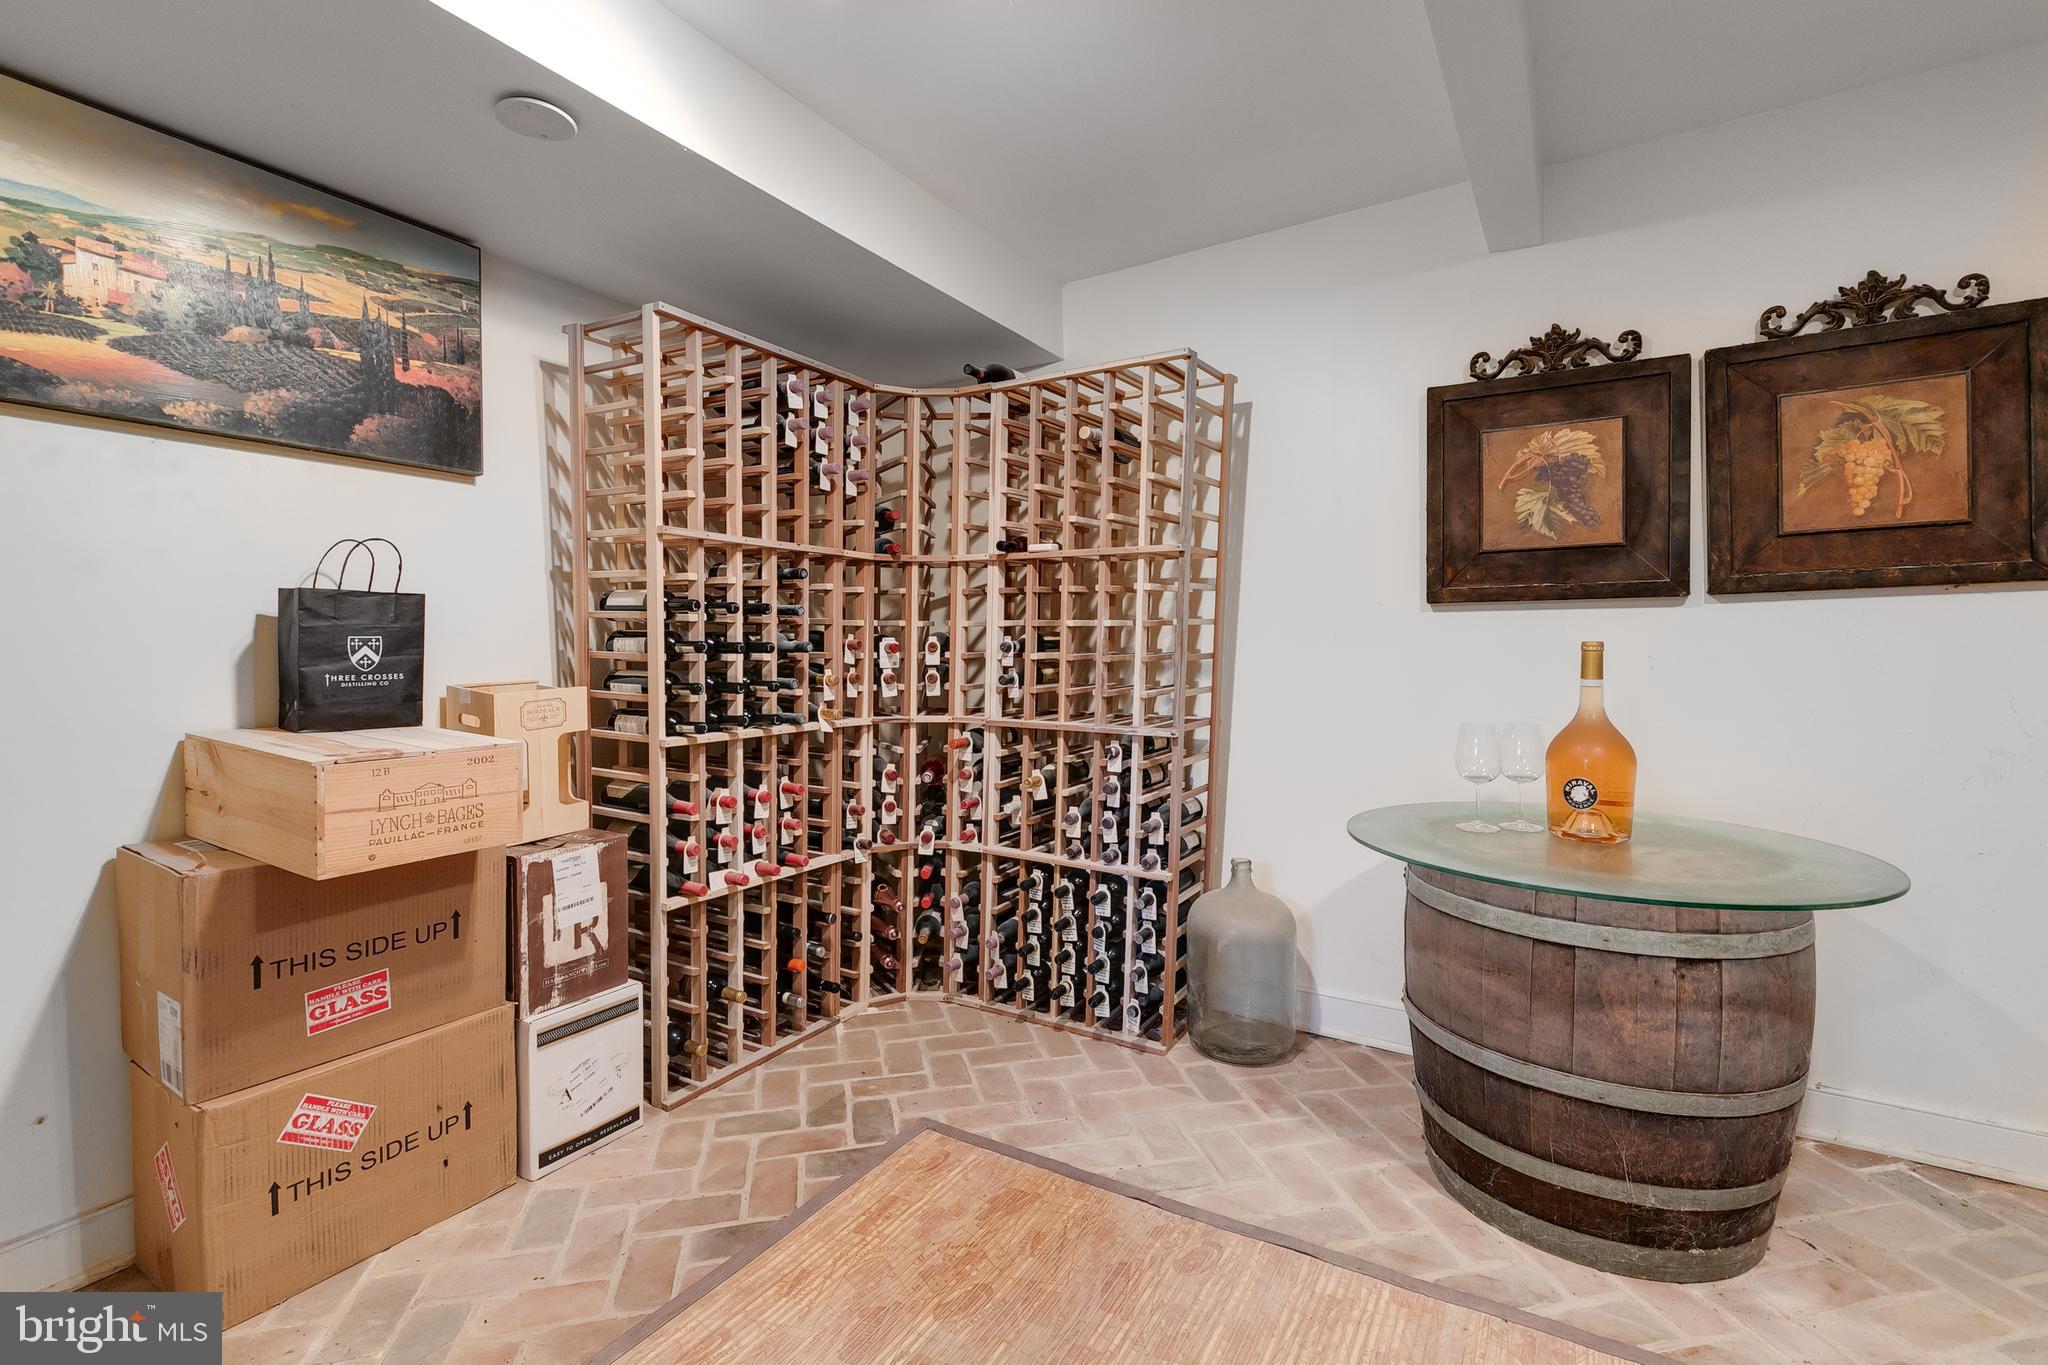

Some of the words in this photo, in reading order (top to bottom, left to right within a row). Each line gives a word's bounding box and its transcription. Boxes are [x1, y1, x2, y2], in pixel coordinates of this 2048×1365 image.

[324, 672, 356, 687] THREE
[361, 672, 404, 681] CROSSES
[340, 680, 377, 688] DISTILLING
[466, 754, 495, 766] 2002
[371, 768, 381, 777] 12
[1565, 779, 1596, 795] MIRAVAL
[369, 812, 423, 836] LYNCH
[437, 802, 484, 824] BAGES
[269, 948, 336, 980] THIS
[346, 930, 406, 961] SIDE
[415, 921, 447, 944] UP
[308, 991, 340, 1006] HANDLE
[341, 984, 361, 995] WITH
[362, 977, 382, 988] CARE
[333, 978, 362, 991] PLEASE
[309, 985, 388, 1021] GLASS
[301, 1103, 330, 1112] HANDLE
[330, 1107, 348, 1116] WITH
[348, 1110, 366, 1119] CARE
[326, 1100, 353, 1109] PLEASE
[292, 1113, 364, 1138] GLASS
[548, 1149, 564, 1161] EASY
[566, 1144, 574, 1152] TO
[575, 1136, 592, 1148] OPEN
[599, 1115, 633, 1136] RESEALABLE
[287, 1161, 352, 1202] THIS
[360, 1130, 419, 1171] SIDE
[428, 1114, 460, 1141] UP
